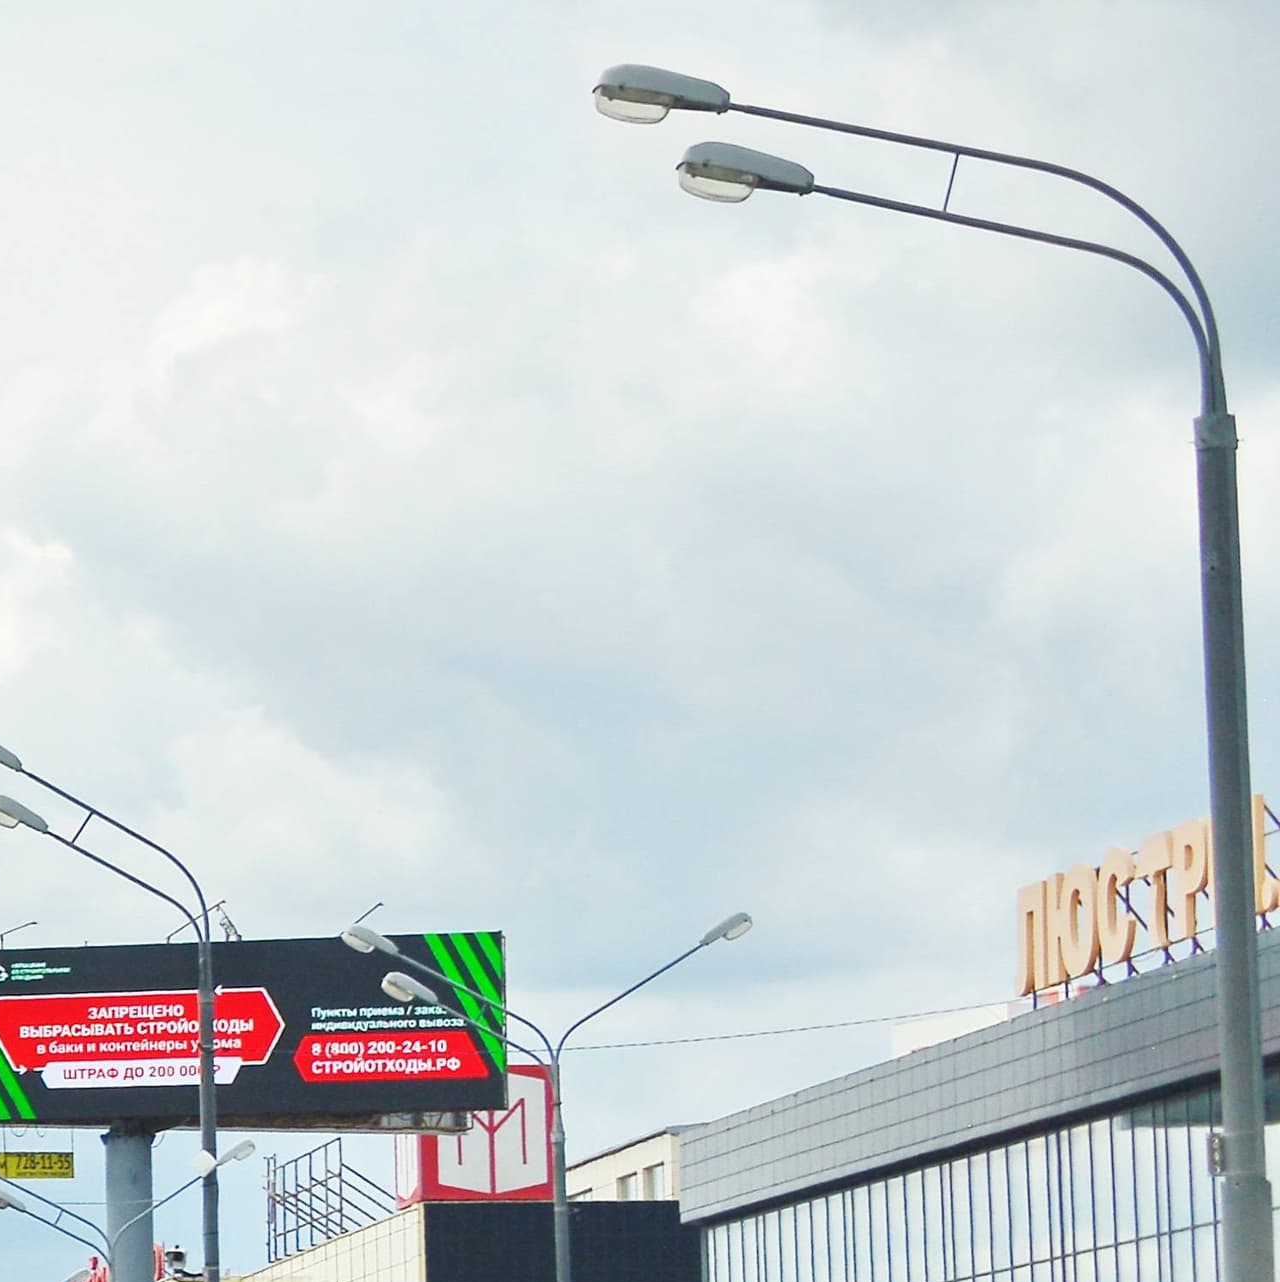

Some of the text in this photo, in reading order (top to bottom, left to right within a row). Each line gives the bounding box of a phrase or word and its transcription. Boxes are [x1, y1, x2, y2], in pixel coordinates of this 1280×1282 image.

[1016, 794, 1264, 997] ЛЮСТР
[87, 1004, 184, 1020] ЗАПРЕЩЕНО
[311, 1006, 357, 1019] Пункты
[414, 1006, 447, 1016] зака
[19, 1018, 254, 1039] ВЫБРАСЫВАТЬ СТРОЙООДЫ
[36, 1044, 46, 1055] в
[48, 1040, 84, 1054] баки
[86, 1042, 97, 1053] и
[99, 1037, 188, 1055] контейнеры
[208, 1037, 242, 1050] ома
[311, 1039, 448, 1058] 8 (800) 200-24-10
[62, 1066, 119, 1080] ШТРАФ
[123, 1066, 145, 1080] ДО
[149, 1064, 175, 1078] 200
[311, 1056, 461, 1075] СТРОЙОТХОДЫ.РФ
